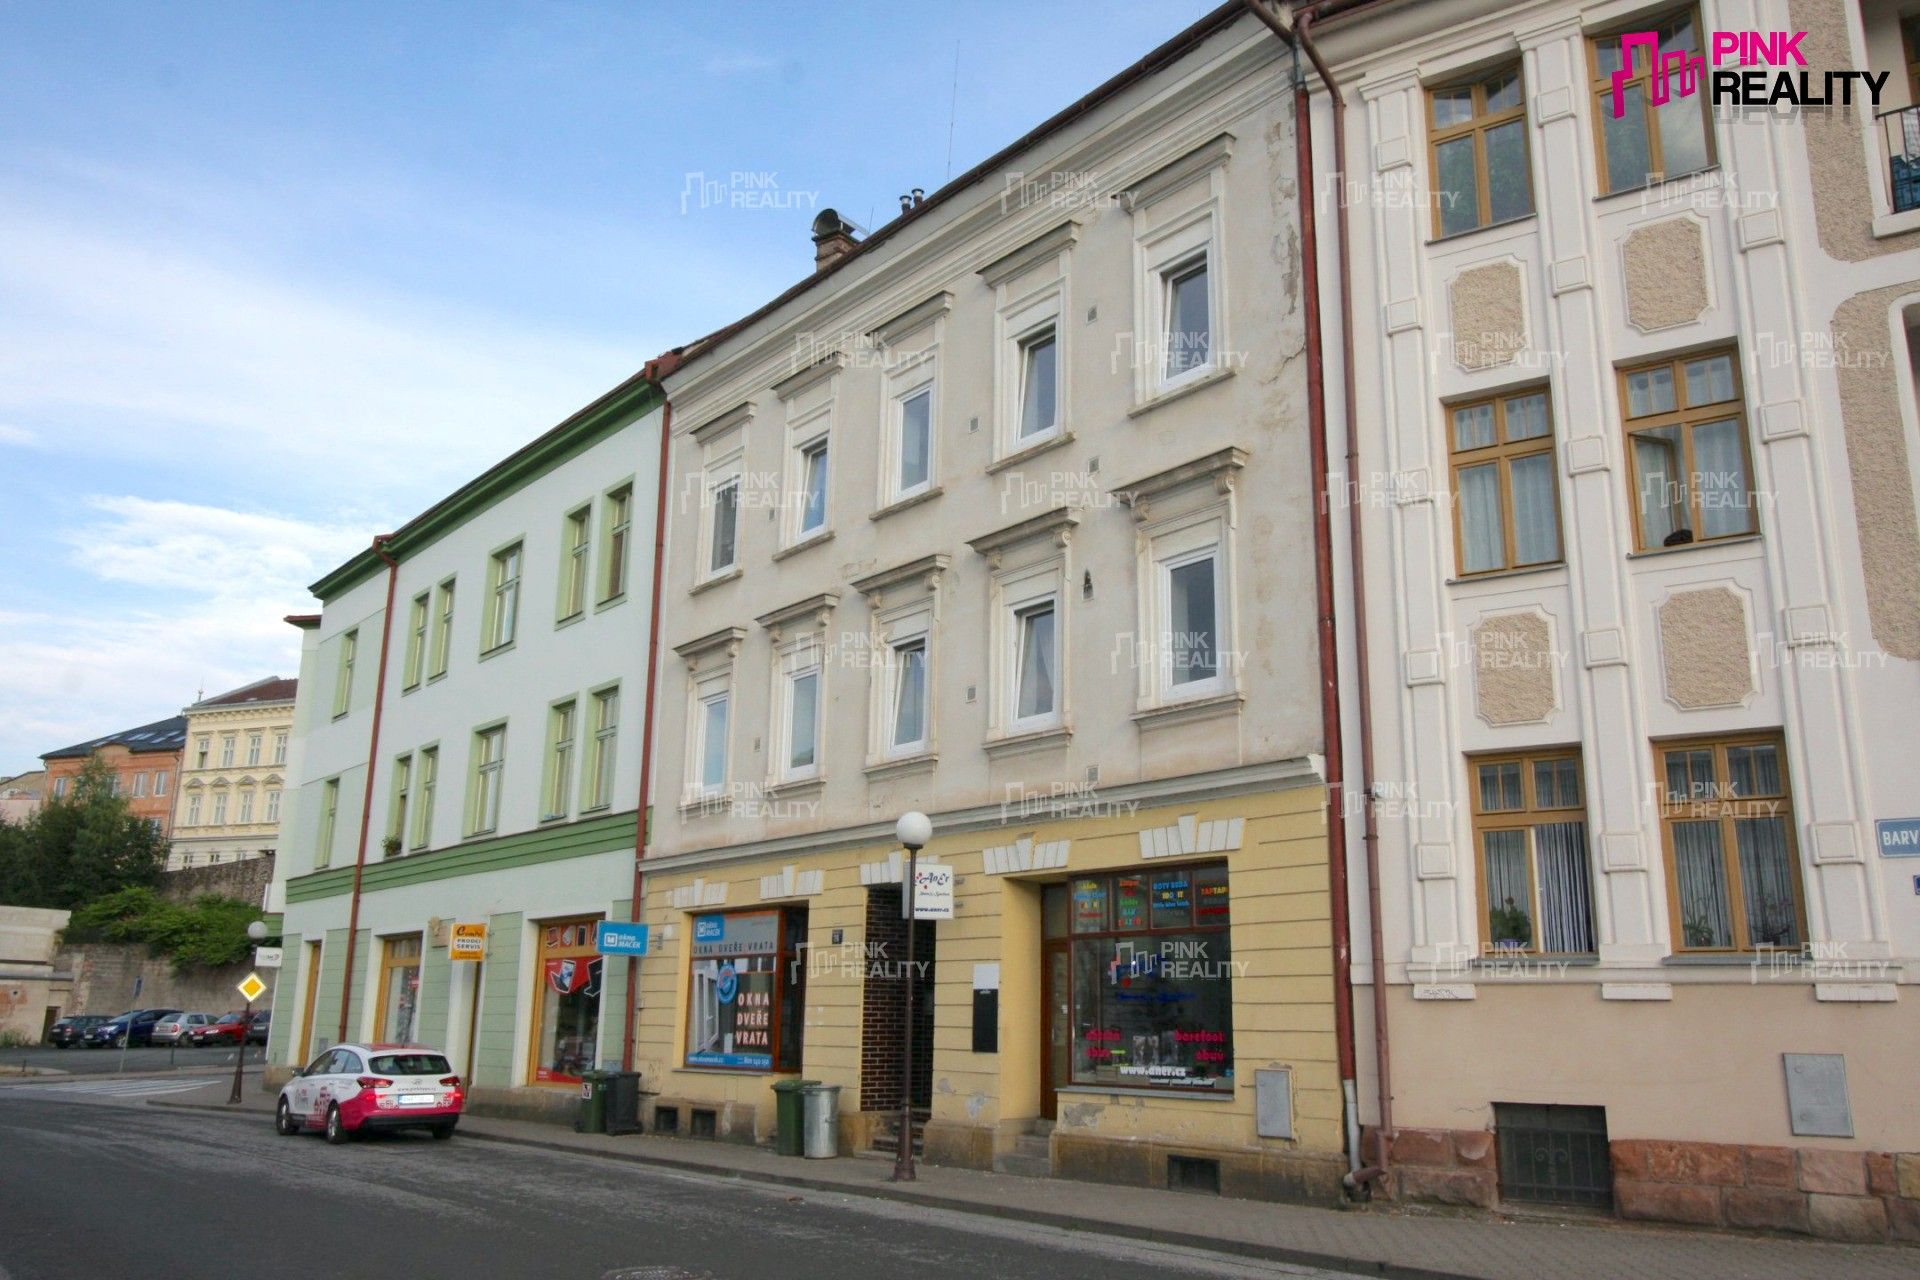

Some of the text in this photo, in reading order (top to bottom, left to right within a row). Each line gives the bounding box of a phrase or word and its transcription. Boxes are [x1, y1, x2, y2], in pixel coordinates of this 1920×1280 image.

[693, 944, 713, 954] OKNA
[748, 941, 774, 951] VRATA
[737, 992, 770, 1007] OKNA
[736, 1009, 769, 1026] DVEŘE
[735, 1030, 769, 1046] VRATA
[1174, 1027, 1225, 1042] barefoot
